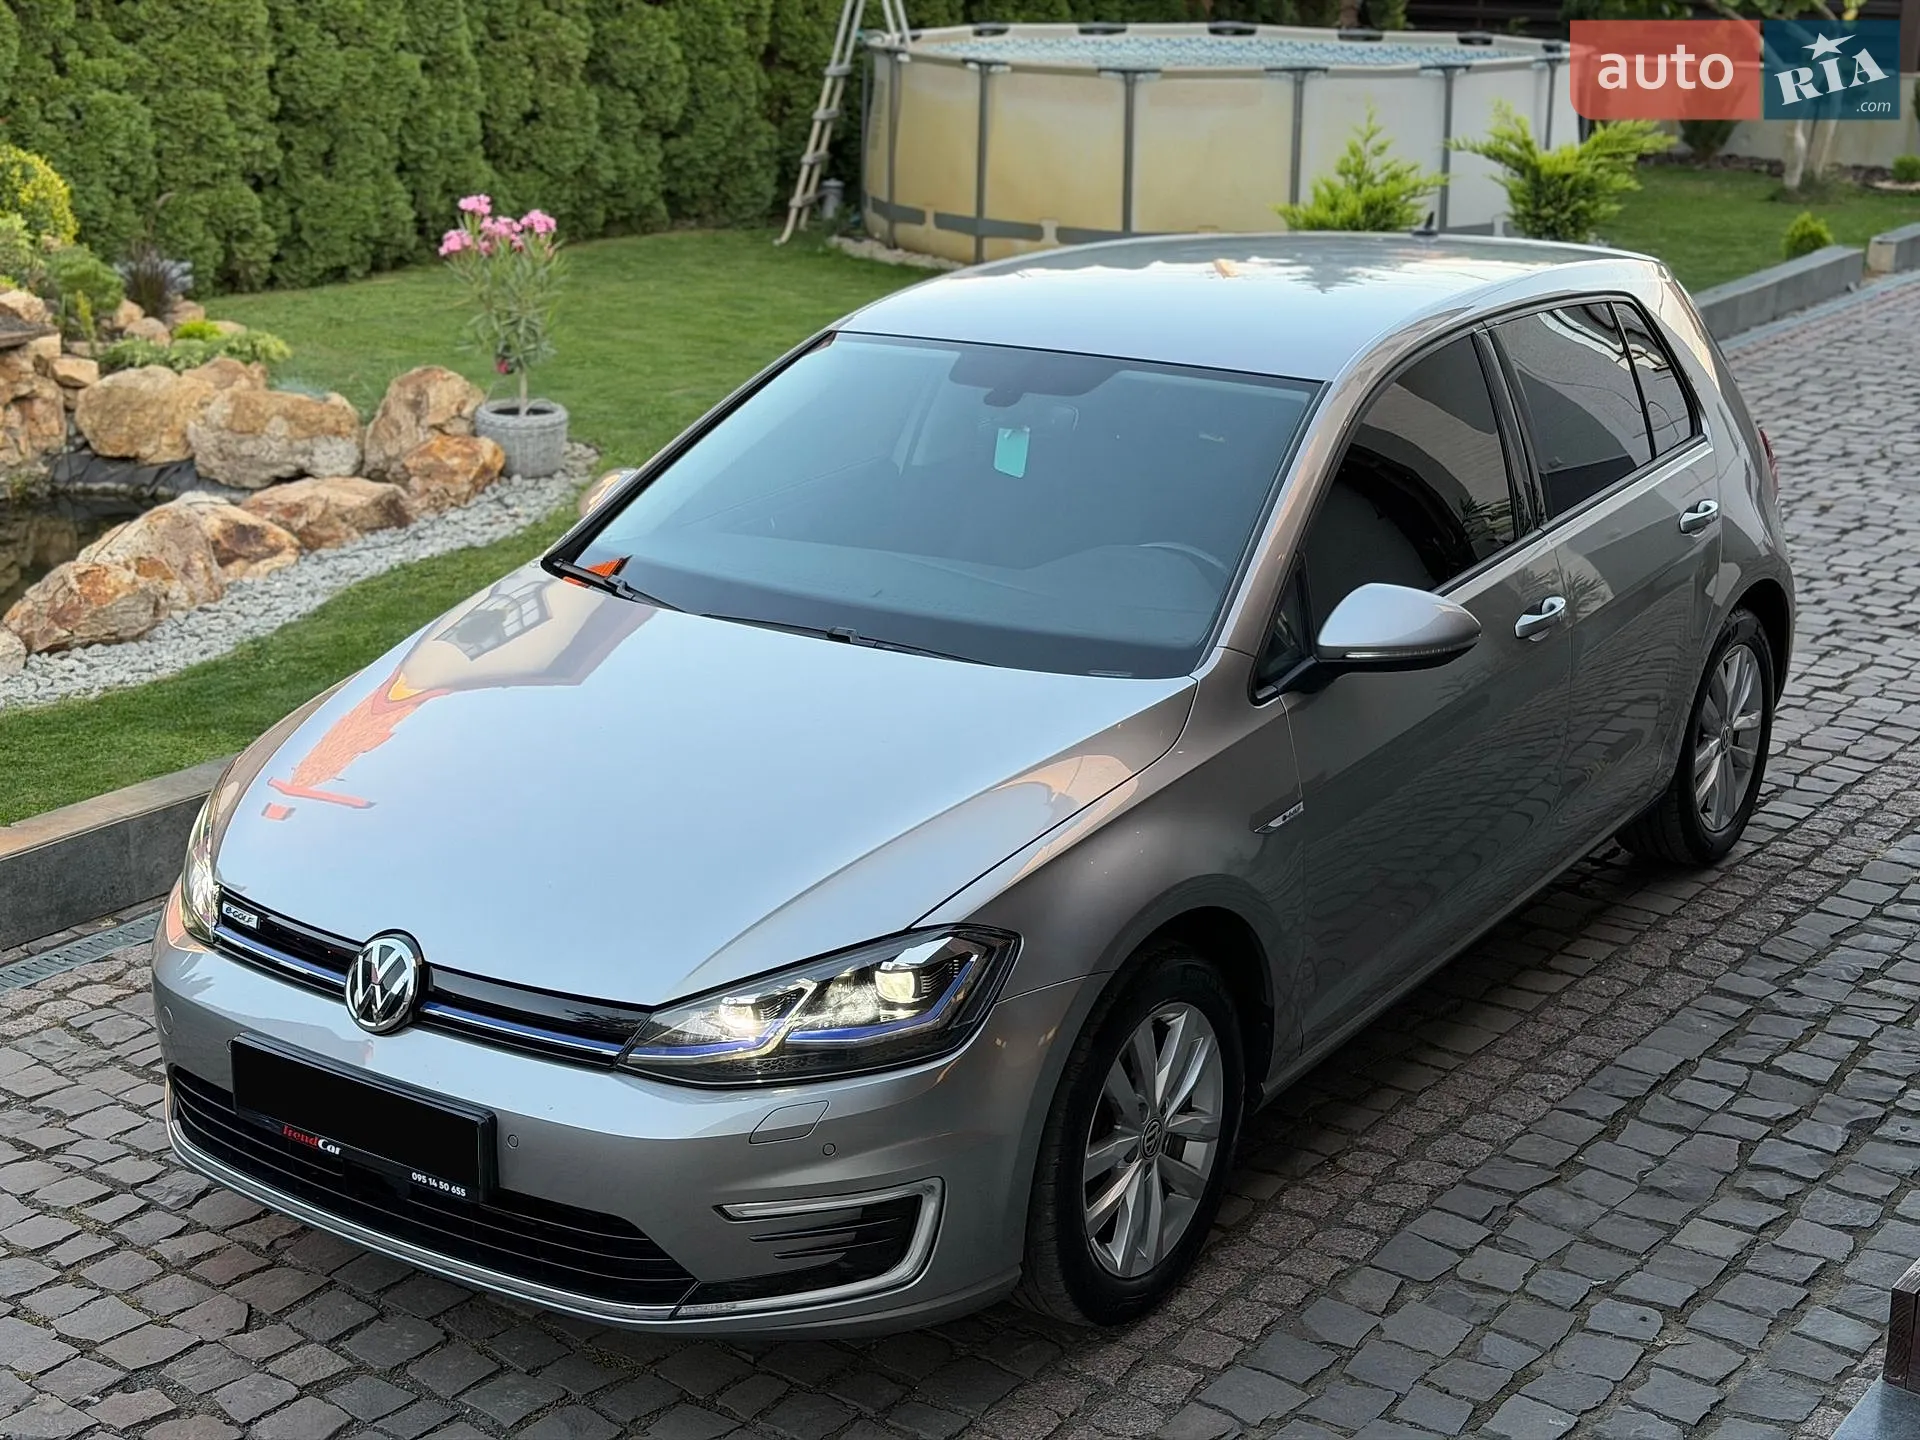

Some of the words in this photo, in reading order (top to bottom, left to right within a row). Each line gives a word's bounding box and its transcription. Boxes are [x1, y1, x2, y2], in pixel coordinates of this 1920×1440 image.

[411, 1171, 427, 1184] 095
[428, 1177, 438, 1188] 14
[439, 1180, 450, 1192] 50
[451, 1185, 466, 1197] 655
